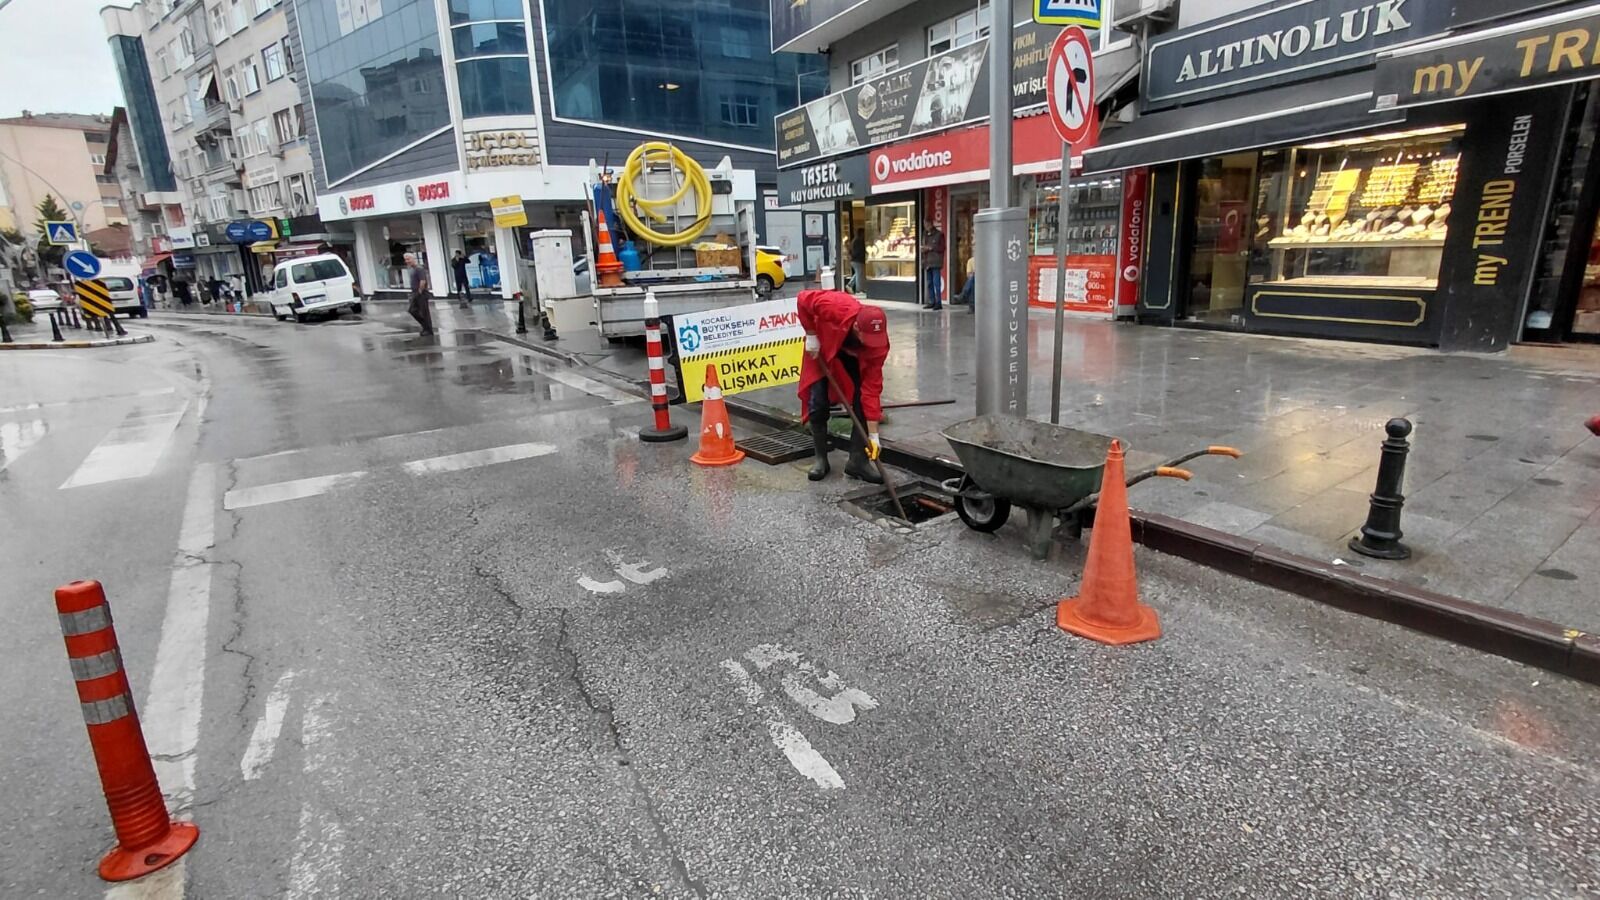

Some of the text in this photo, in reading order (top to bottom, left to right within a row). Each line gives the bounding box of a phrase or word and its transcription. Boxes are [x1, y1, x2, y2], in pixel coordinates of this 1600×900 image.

[1175, 0, 1412, 83] ALTINOLUK
[1412, 28, 1600, 97] my TR
[1503, 114, 1533, 175] PORSELEN
[892, 149, 952, 174] vodafone
[801, 163, 838, 187] TAŞER
[349, 194, 375, 211] BOSCH
[418, 181, 450, 202] BOSCH
[790, 183, 851, 203] KUYUMCULUK
[1129, 199, 1142, 261] vodafone
[1472, 179, 1516, 286] my TREND
[721, 354, 777, 375] DİKKAT
[771, 366, 800, 381] VAR
